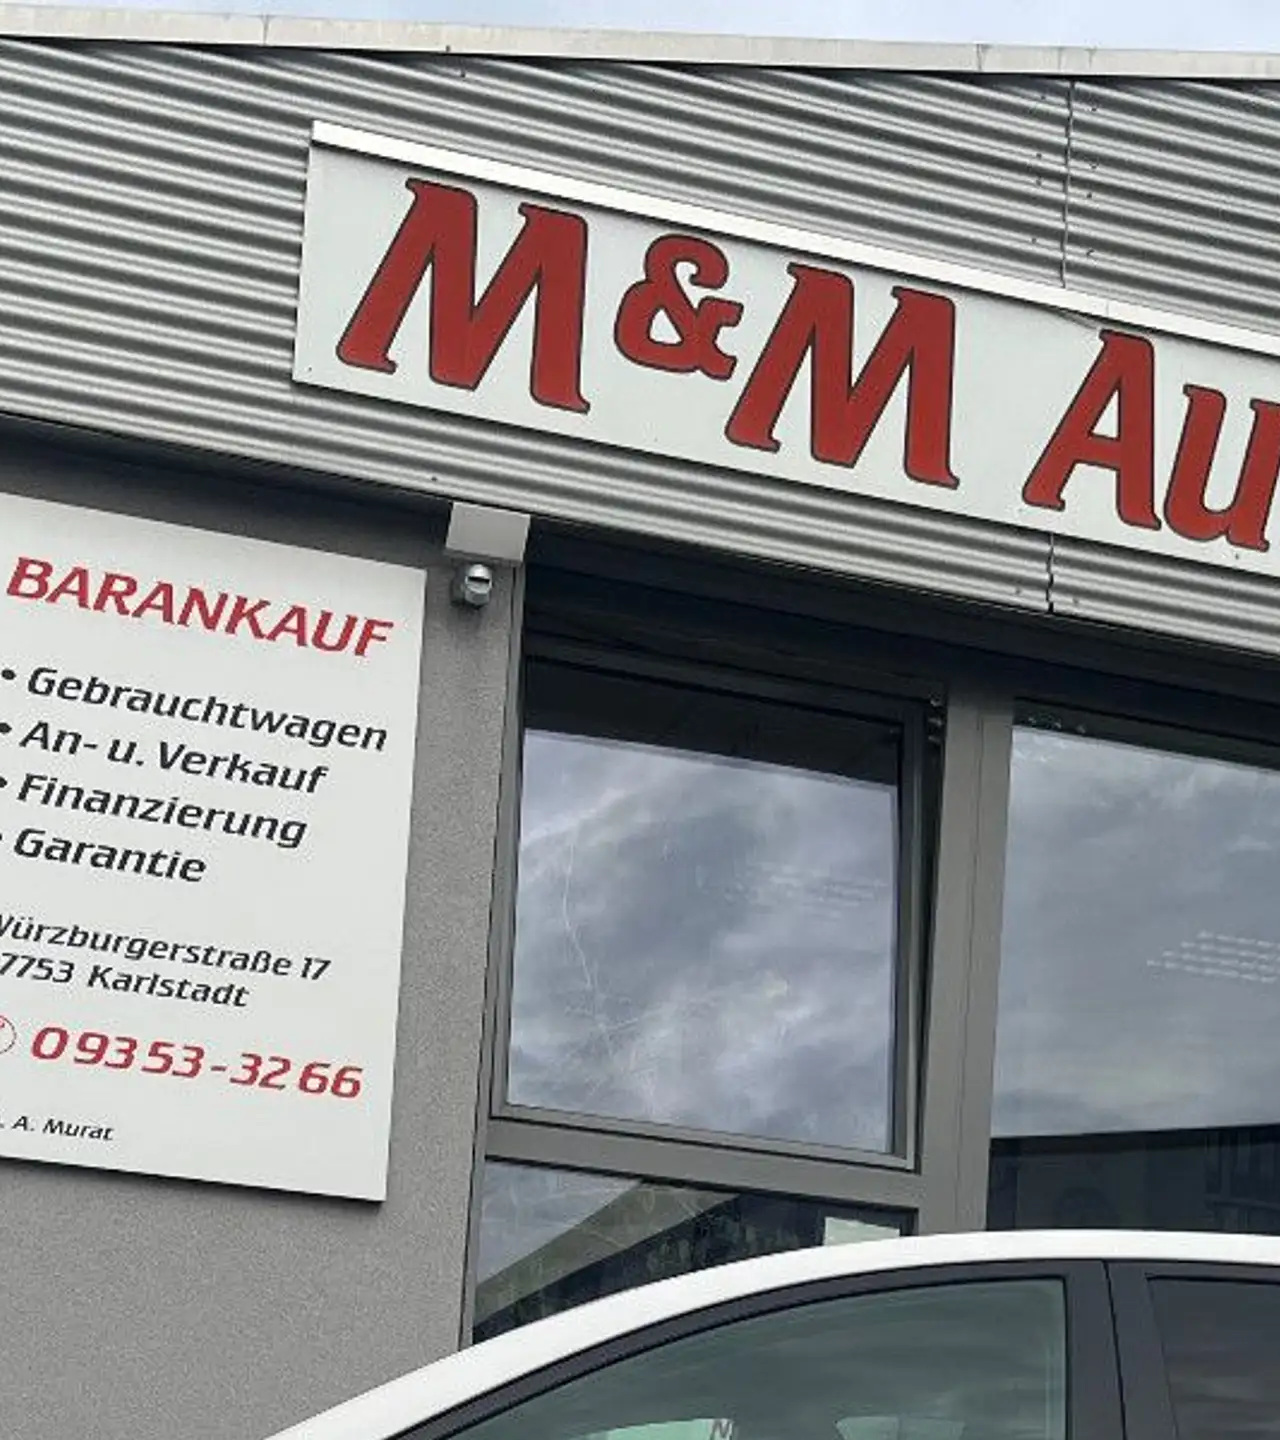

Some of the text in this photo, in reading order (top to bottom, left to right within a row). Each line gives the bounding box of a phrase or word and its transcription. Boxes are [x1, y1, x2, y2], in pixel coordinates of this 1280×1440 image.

[6, 556, 395, 658] BARANKAUF
[26, 666, 389, 752] Gebrauchtwagen
[18, 720, 329, 793] An- u. Verkauf
[16, 772, 309, 850] Finanzierung
[12, 827, 208, 883] Garantie
[86, 963, 252, 1008] Karlstadt
[300, 956, 333, 982] 17
[11, 1115, 36, 1132] A.
[42, 1118, 114, 1141] Murat
